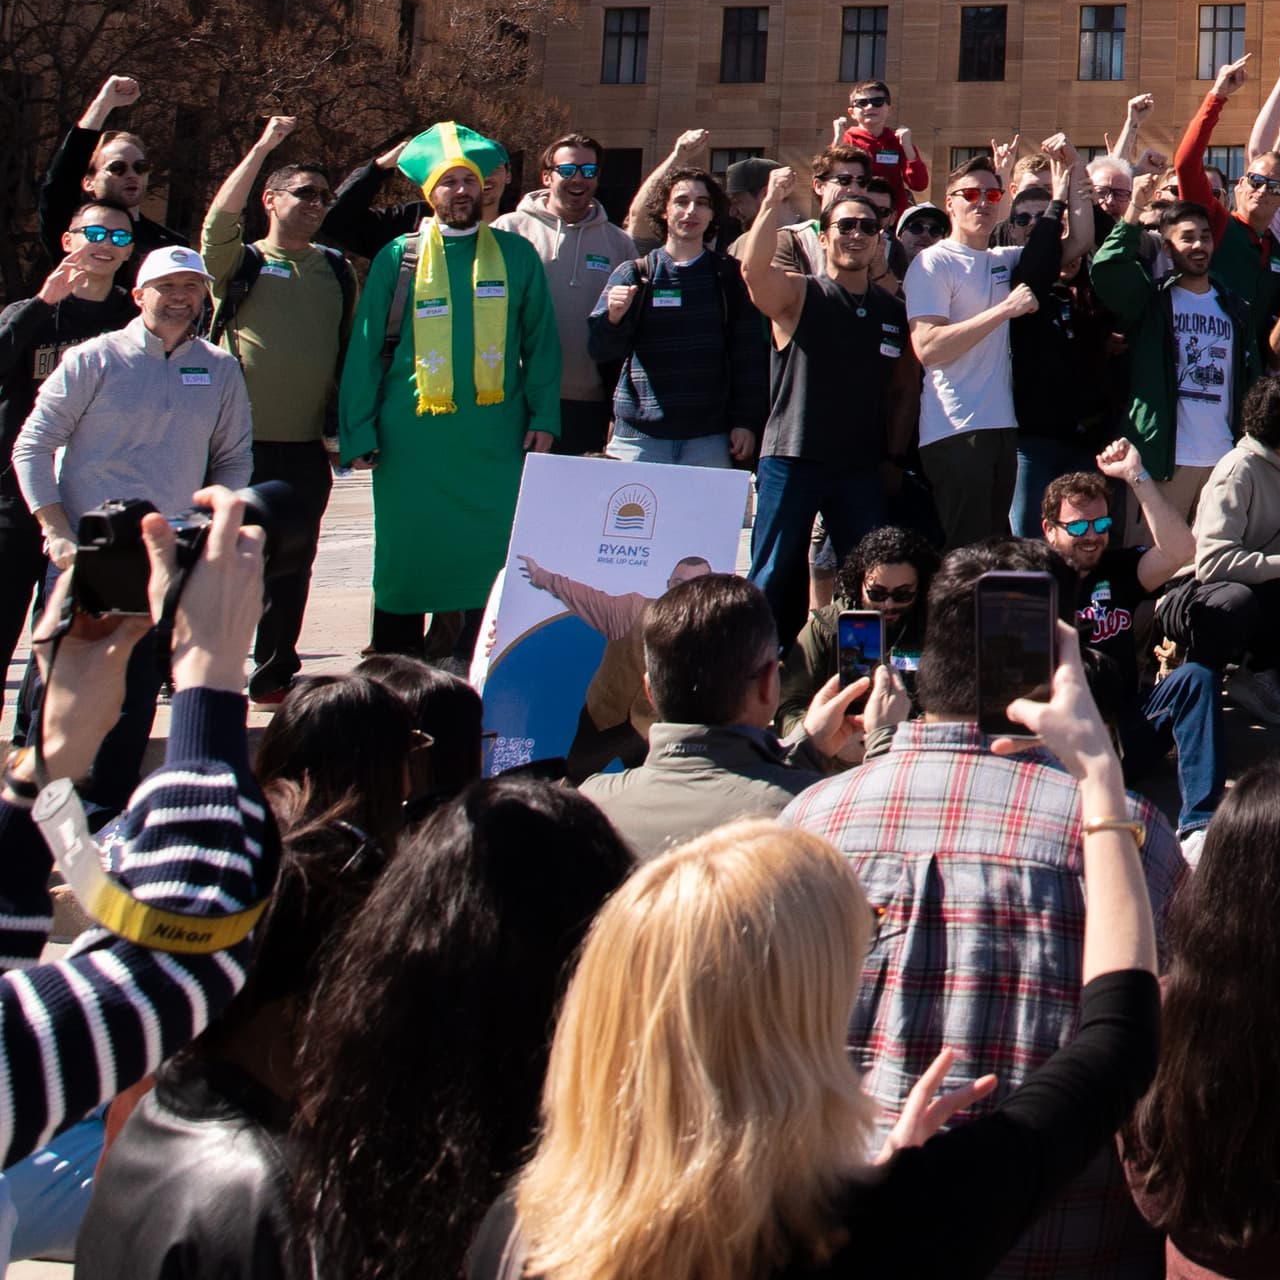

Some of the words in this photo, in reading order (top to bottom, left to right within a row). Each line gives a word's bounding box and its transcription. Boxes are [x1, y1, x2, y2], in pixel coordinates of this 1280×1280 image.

[599, 543, 651, 559] RYAN'S
[629, 559, 649, 567] CAFE
[153, 922, 213, 943] Nikon
